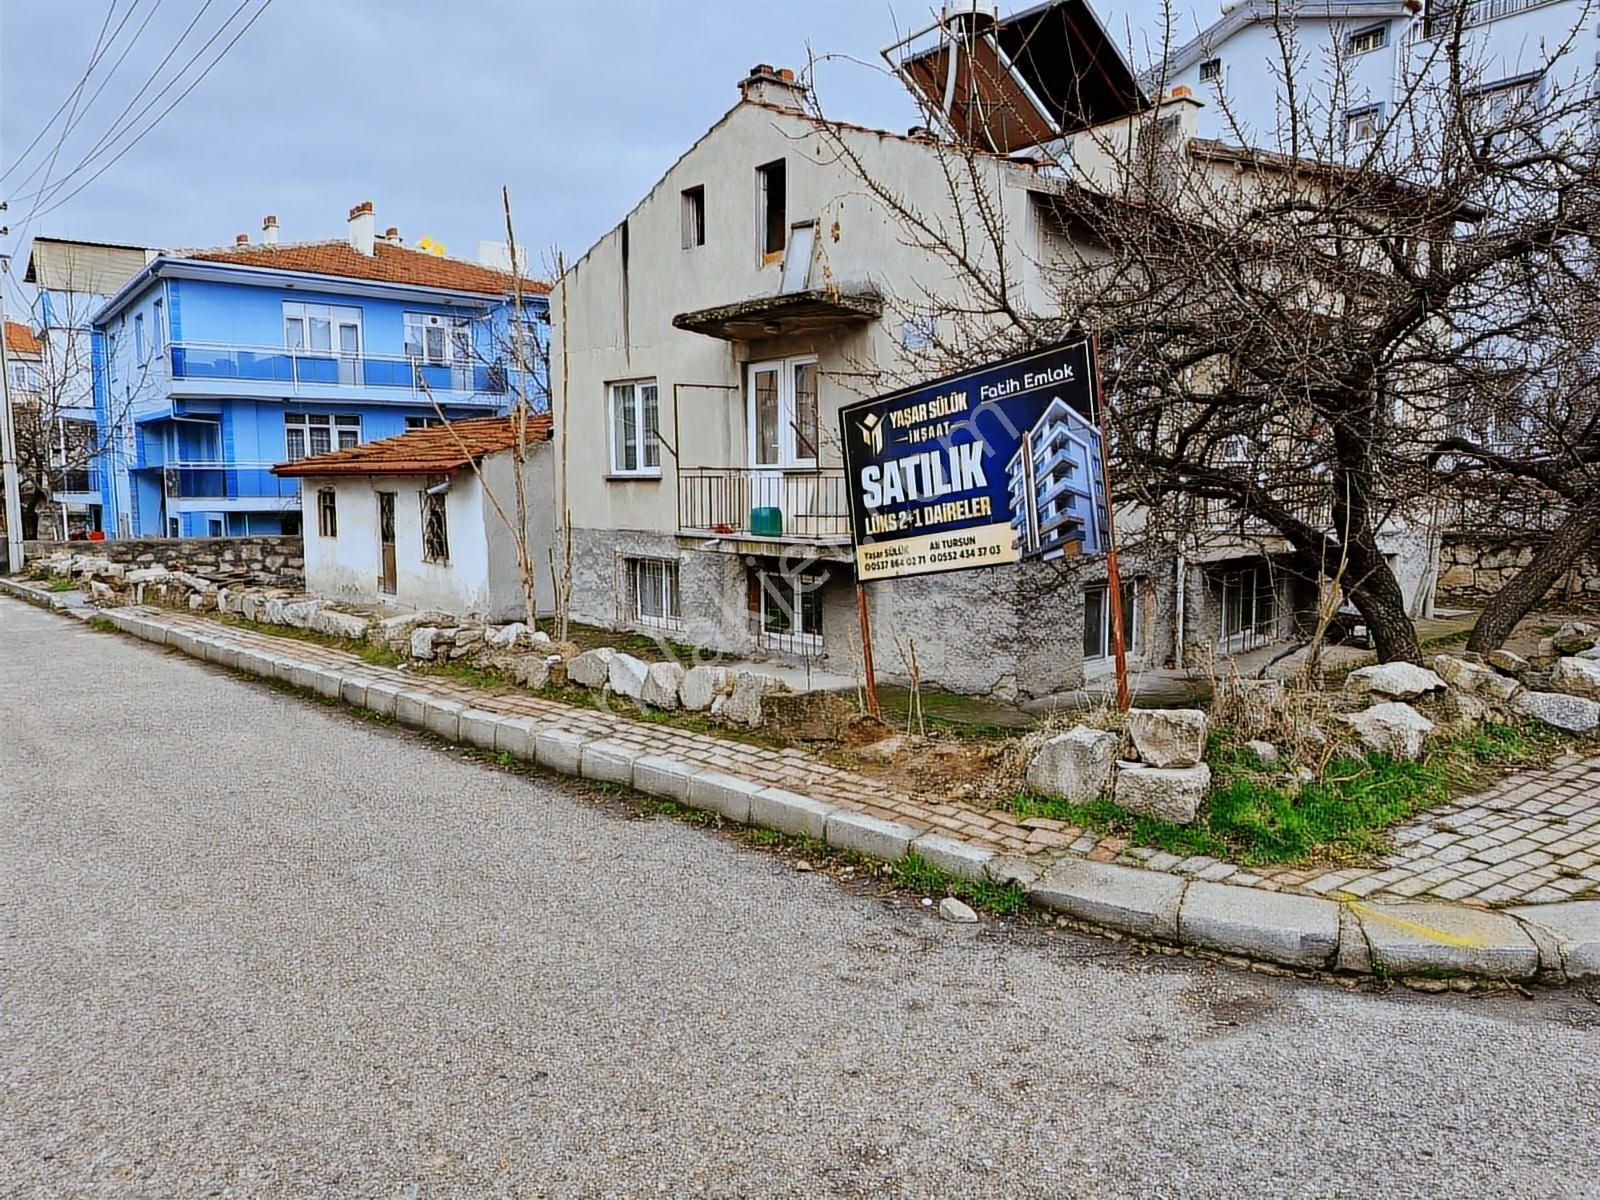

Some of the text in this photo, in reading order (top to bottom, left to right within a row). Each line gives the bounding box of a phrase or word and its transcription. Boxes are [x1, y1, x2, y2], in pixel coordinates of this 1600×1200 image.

[980, 363, 1074, 400] Fatih Emlak
[890, 391, 968, 429] YAŞAR SÜLÜK
[861, 440, 988, 509] SATILIK
[924, 495, 992, 526] DAİRELER
[941, 535, 976, 549] TURSUN
